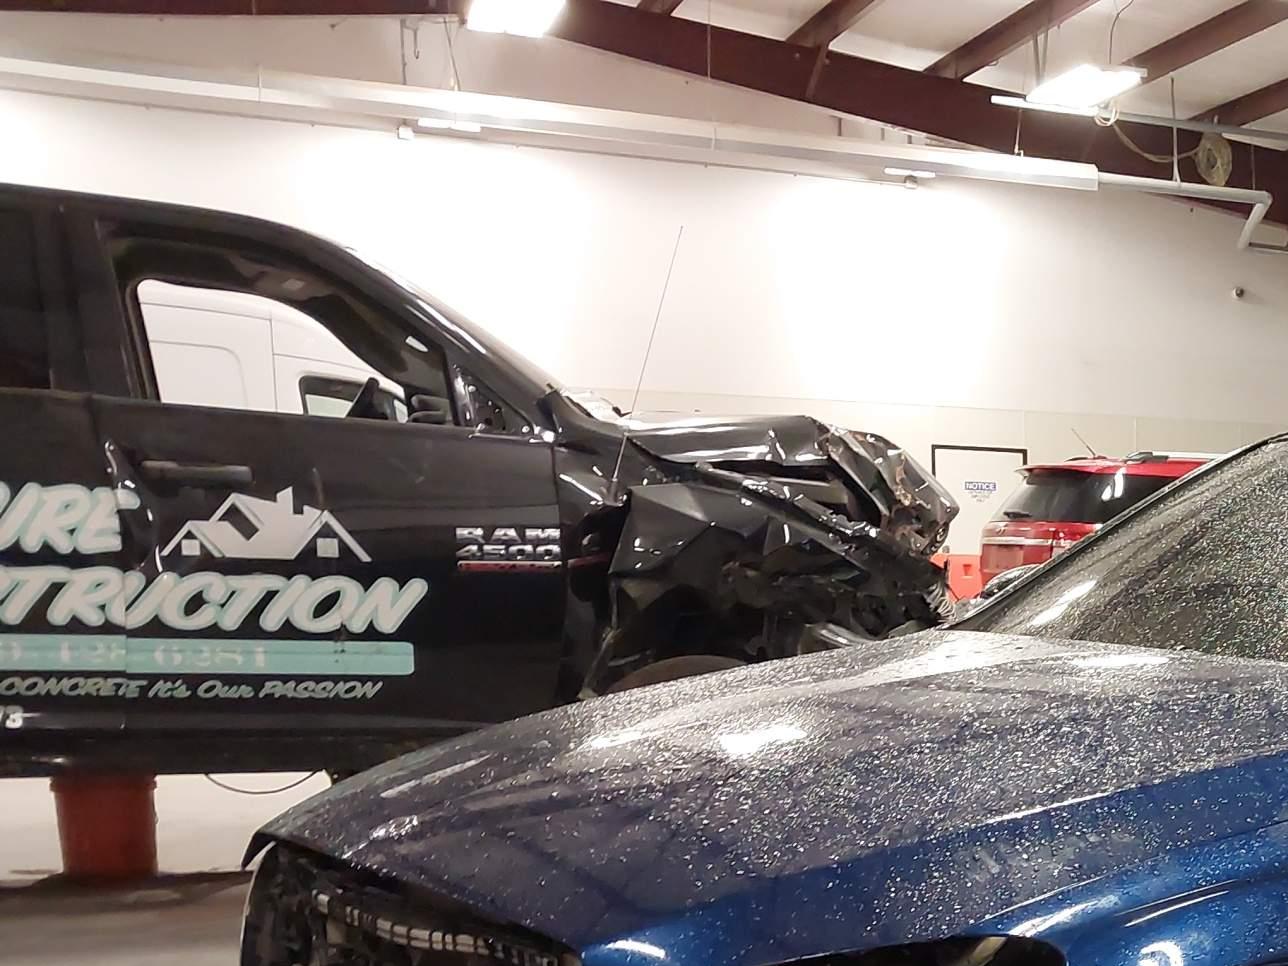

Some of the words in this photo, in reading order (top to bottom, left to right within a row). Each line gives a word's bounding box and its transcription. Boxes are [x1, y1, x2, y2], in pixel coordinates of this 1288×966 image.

[964, 482, 997, 491] NOTICE
[456, 527, 561, 544] RAM
[0, 676, 148, 698] CONCRETE
[258, 681, 384, 700] PASSION
